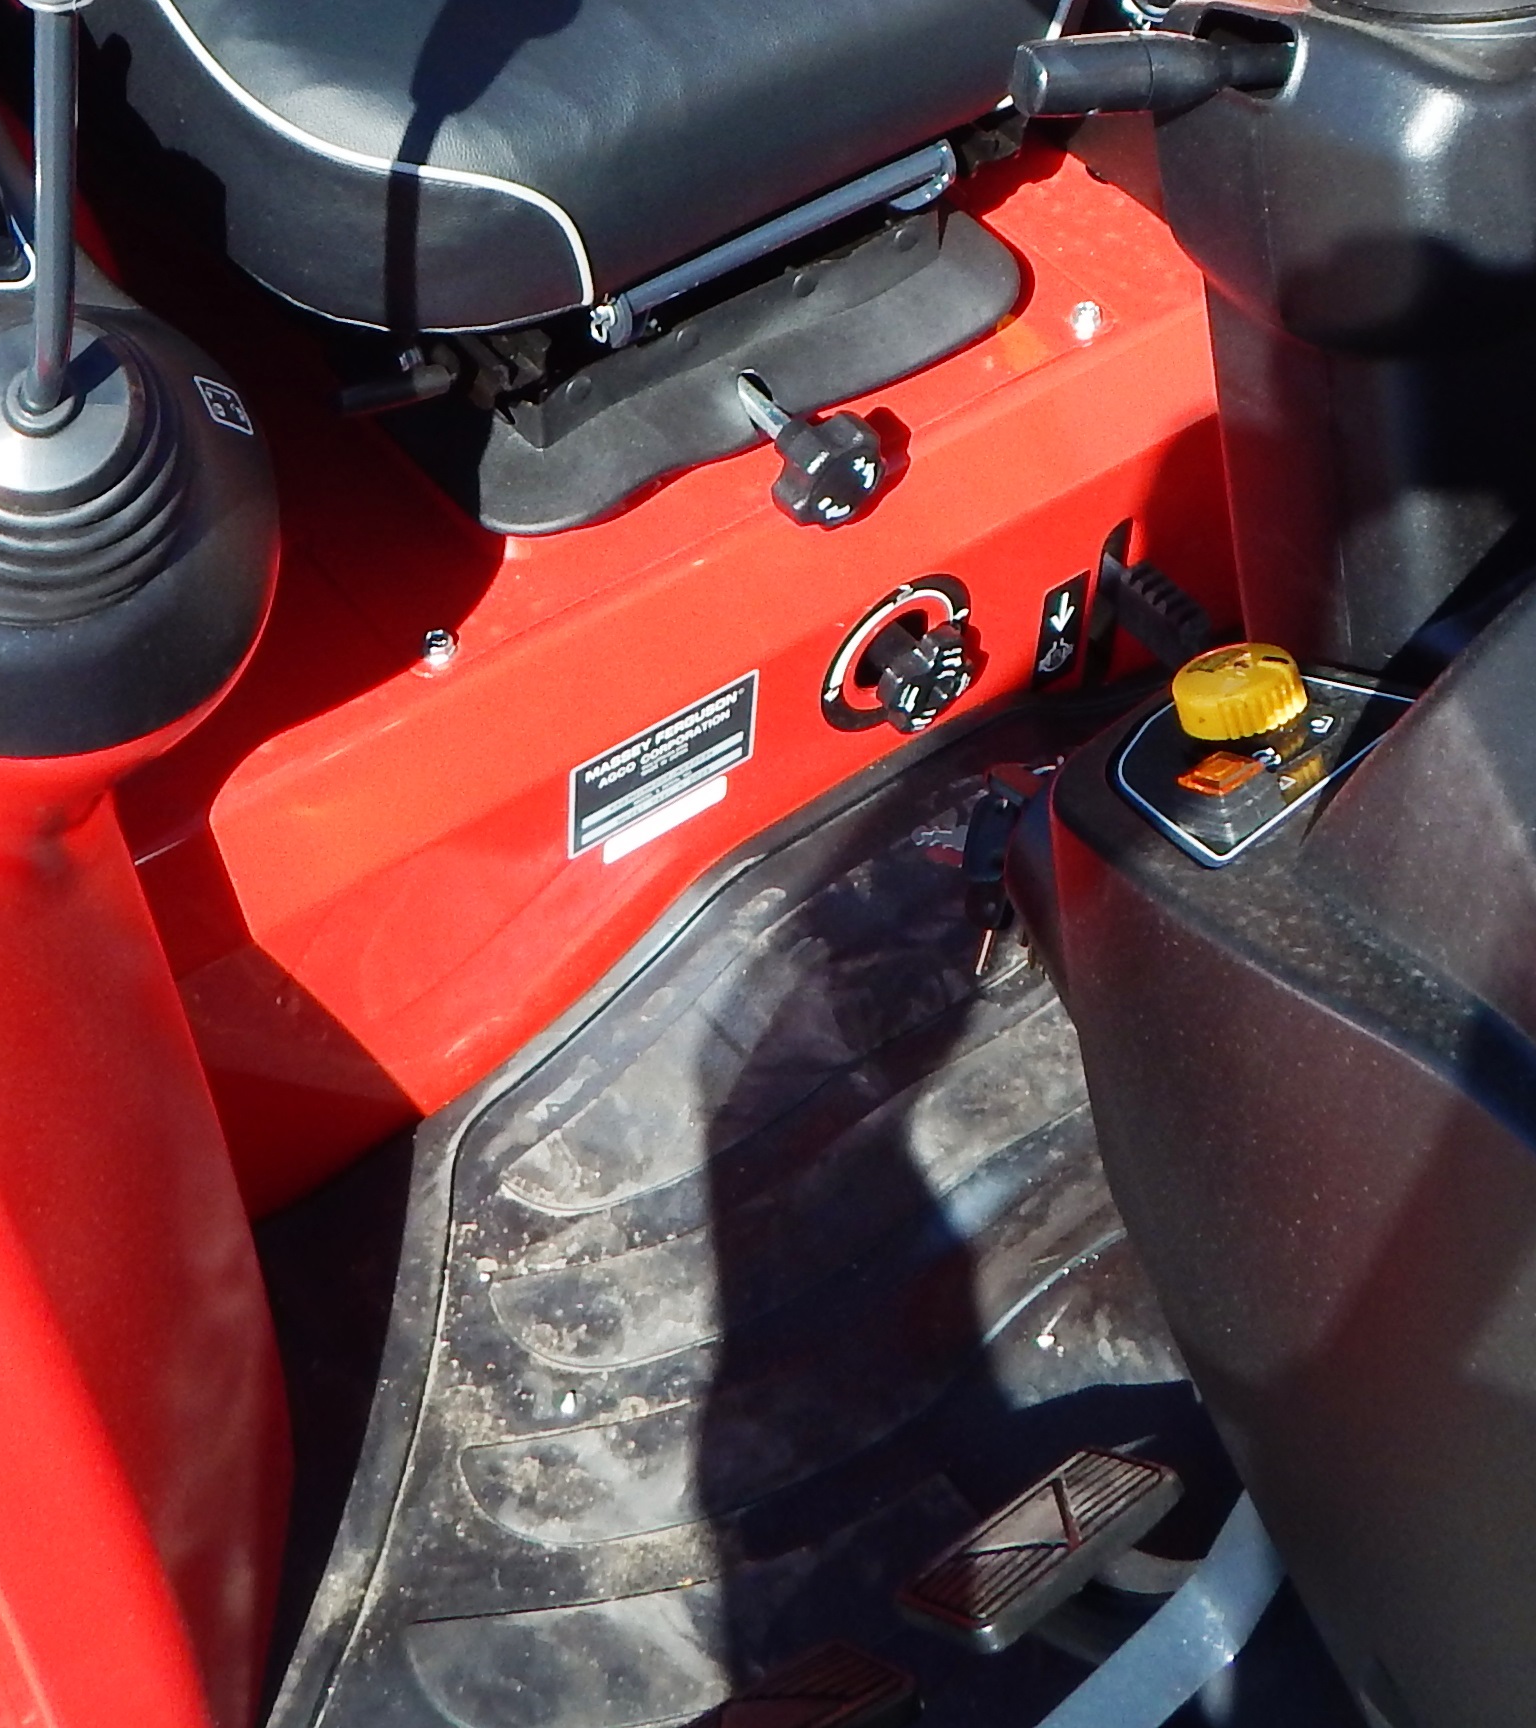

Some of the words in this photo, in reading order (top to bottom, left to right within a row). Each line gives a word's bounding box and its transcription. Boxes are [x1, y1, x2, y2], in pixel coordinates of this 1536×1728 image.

[584, 737, 652, 784] MASSEY
[654, 689, 739, 745] FERGUSON
[598, 761, 638, 790] AGCO
[639, 708, 731, 765] CORPORATION
